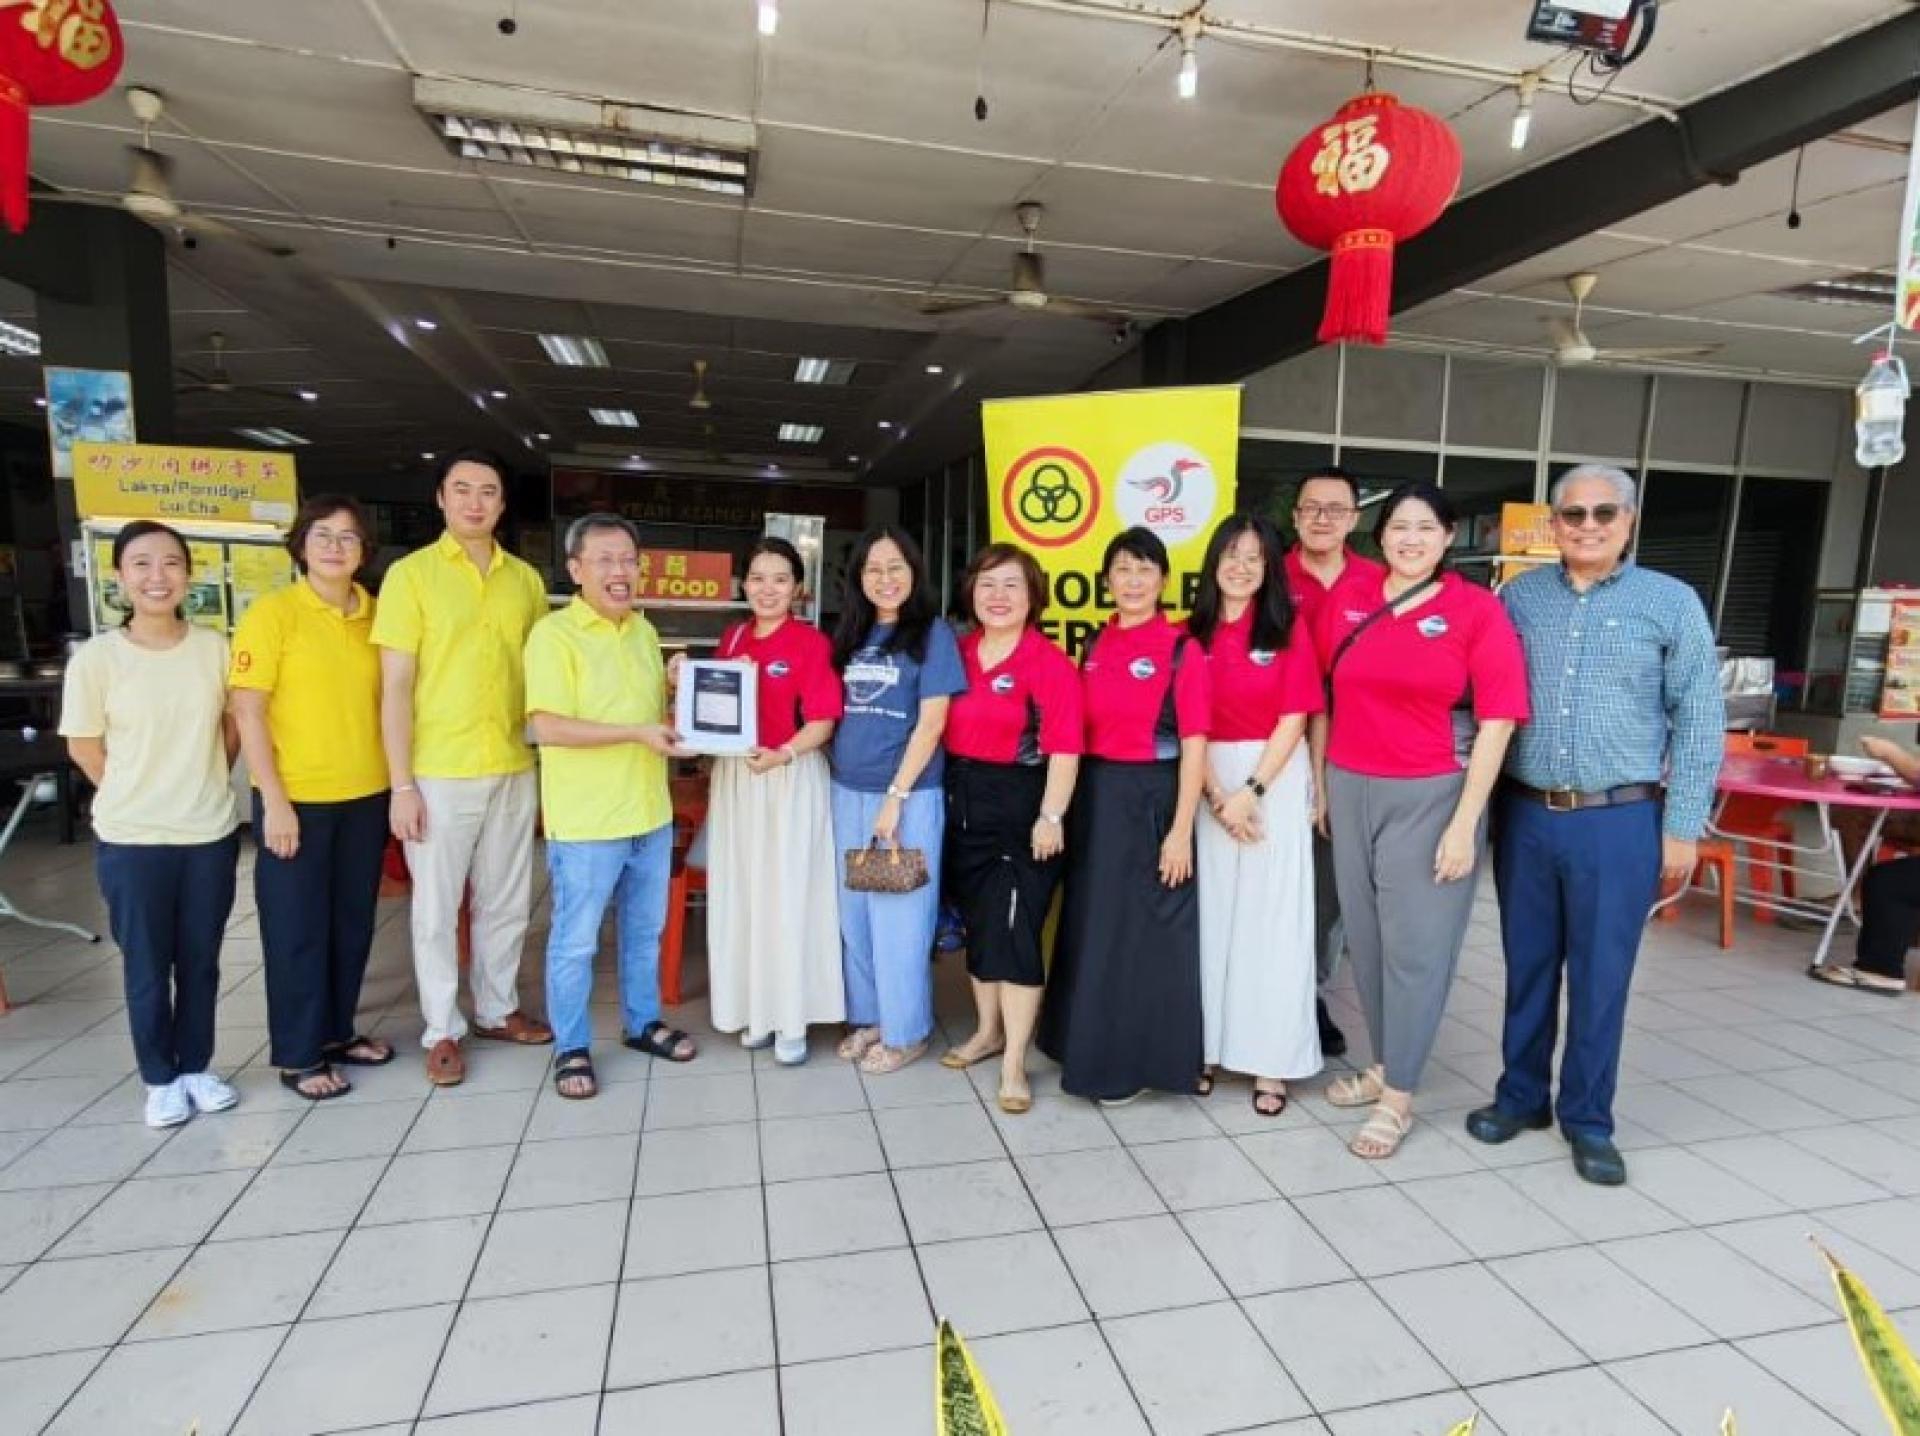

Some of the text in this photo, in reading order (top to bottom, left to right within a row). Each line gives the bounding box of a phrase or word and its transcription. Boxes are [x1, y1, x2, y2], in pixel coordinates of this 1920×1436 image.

[1310, 114, 1391, 197] 福
[1144, 507, 1185, 523] GPS
[657, 578, 719, 597] FOOD
